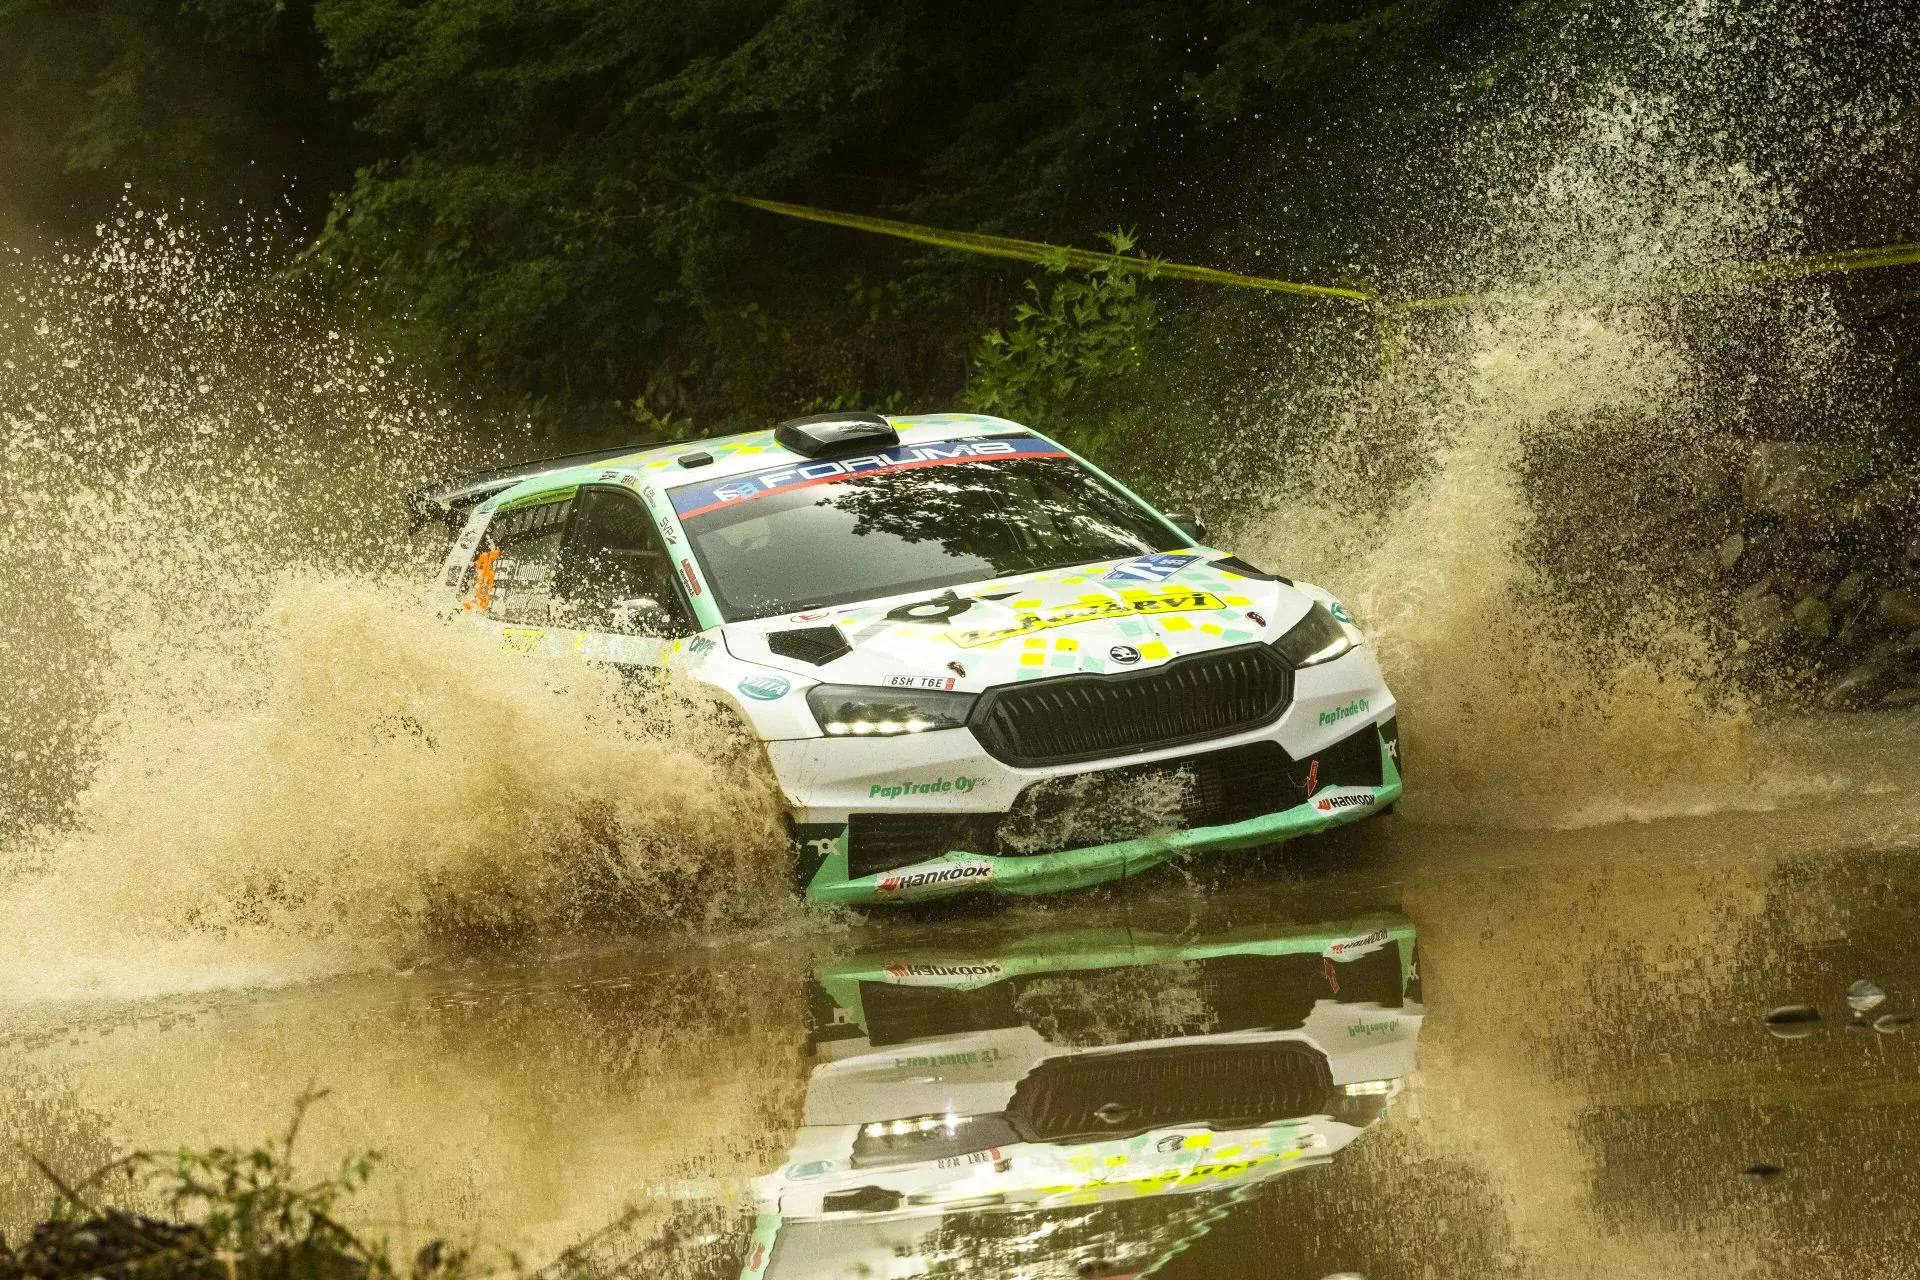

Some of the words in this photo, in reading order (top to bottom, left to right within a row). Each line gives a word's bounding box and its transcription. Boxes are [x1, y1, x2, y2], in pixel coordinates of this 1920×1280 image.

[757, 441, 1017, 488] FORUM8
[891, 676, 914, 686] 6SH
[921, 677, 943, 688] T6E
[1319, 701, 1359, 726] PapTrade
[869, 777, 952, 799] PapTrade
[955, 776, 976, 793] Oy
